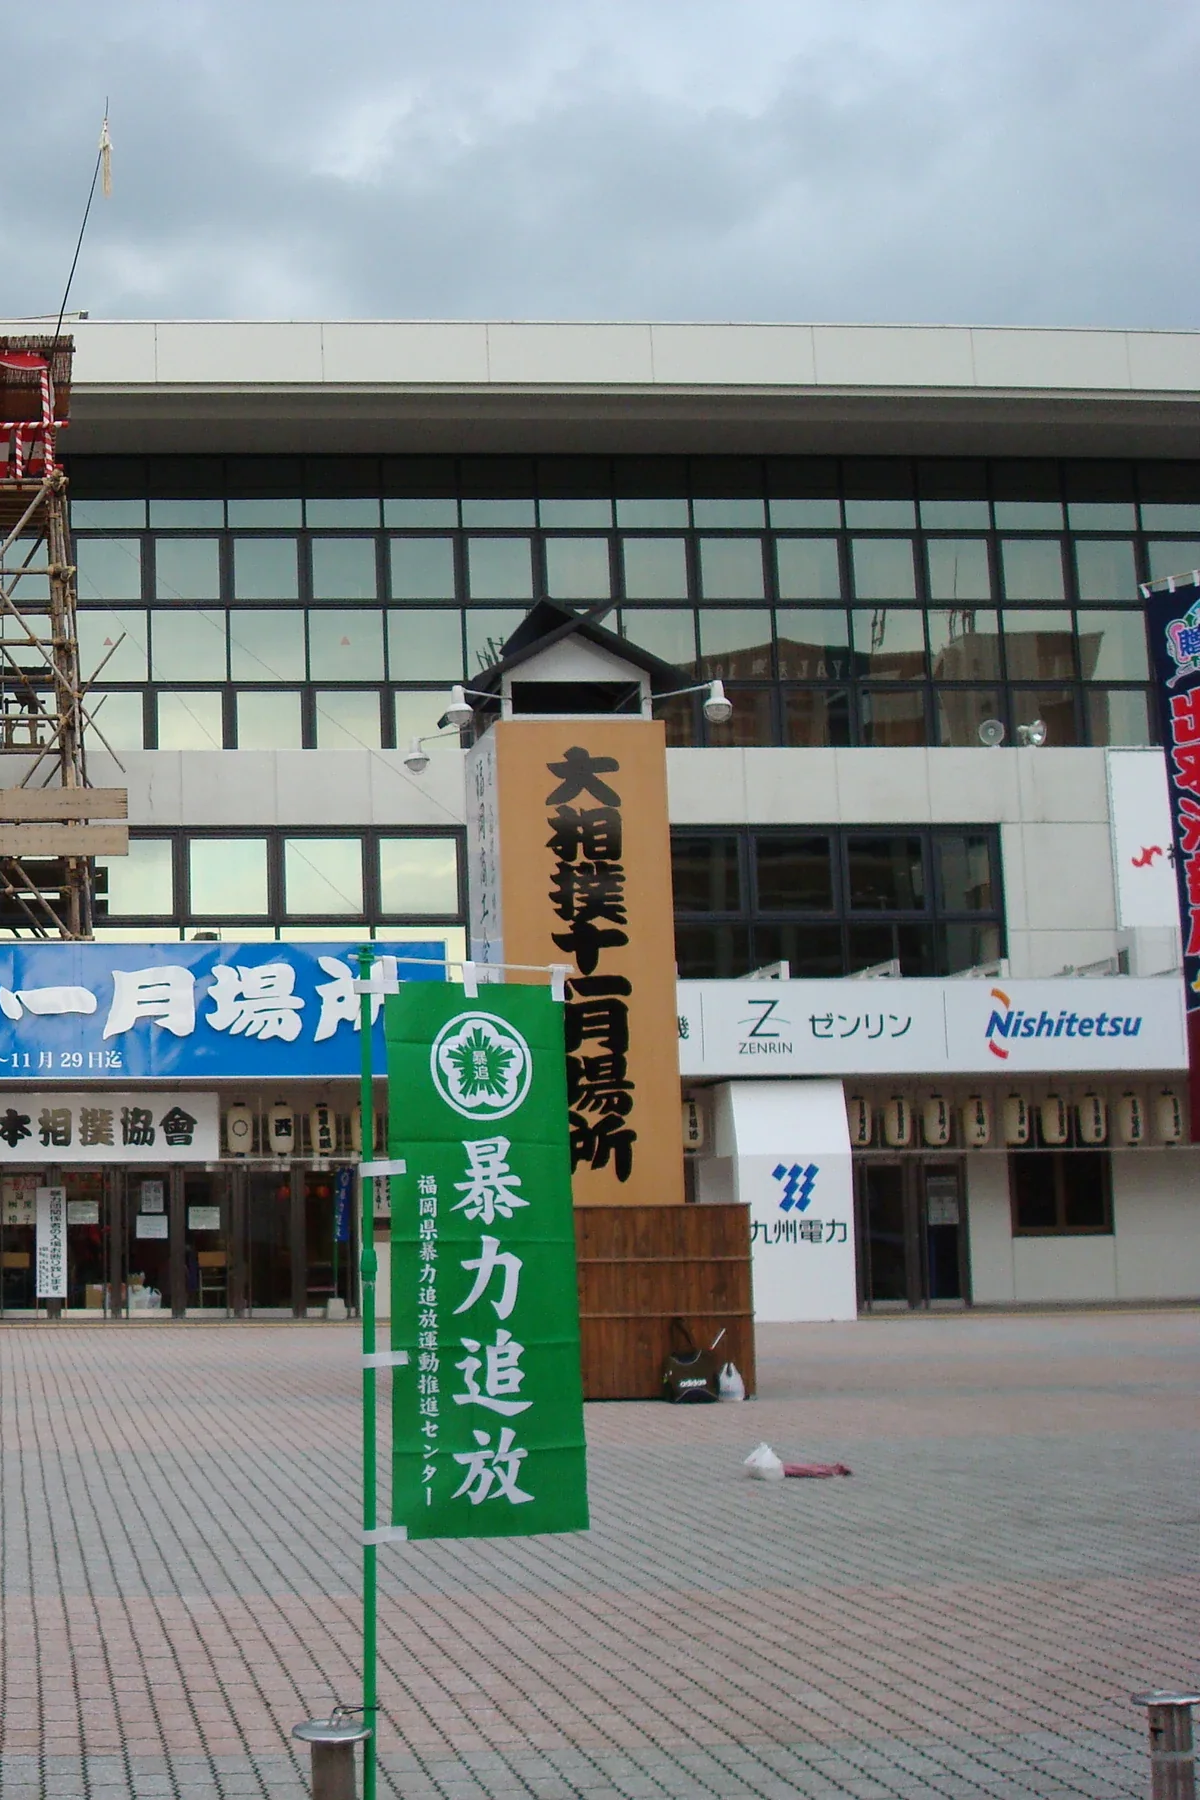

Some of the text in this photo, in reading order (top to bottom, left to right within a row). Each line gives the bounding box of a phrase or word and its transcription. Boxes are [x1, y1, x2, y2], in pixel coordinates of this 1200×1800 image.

[545, 746, 637, 1183] 大相撲十一月場所
[808, 1013, 912, 1040] ゼンリン
[984, 1008, 1142, 1039] Nishitetsu
[738, 1042, 793, 1055] ZENRIN
[274, 1118, 292, 1137] 西
[750, 1219, 848, 1245] 九州電力
[449, 1136, 537, 1506] 暴力追放
[416, 1173, 441, 1506] 福岡県暴力追放運動推進センター
[680, 1379, 708, 1388] adidas
